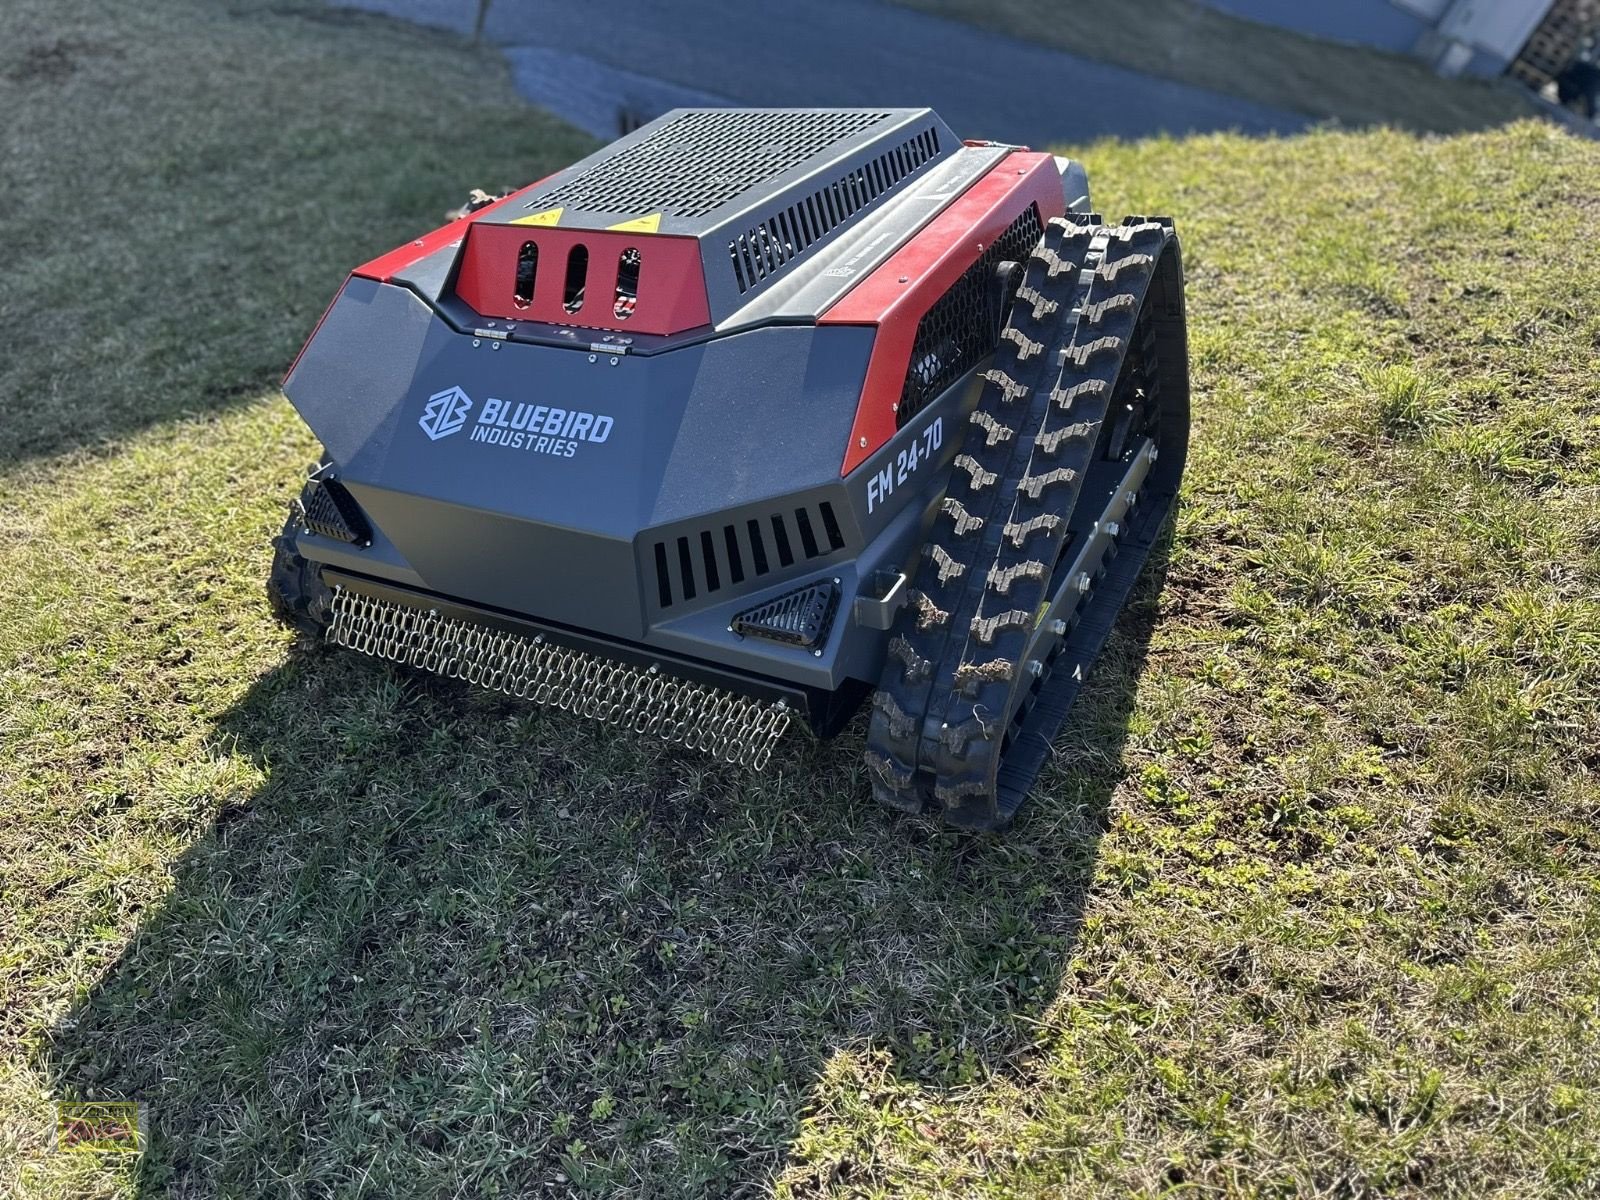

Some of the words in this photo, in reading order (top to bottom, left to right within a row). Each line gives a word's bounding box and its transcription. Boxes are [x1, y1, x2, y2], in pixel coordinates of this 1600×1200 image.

[470, 425, 578, 458] INDUSTRIES
[478, 398, 614, 443] BLUEBIRD
[867, 461, 893, 514] FM
[897, 416, 942, 487] 24-70
